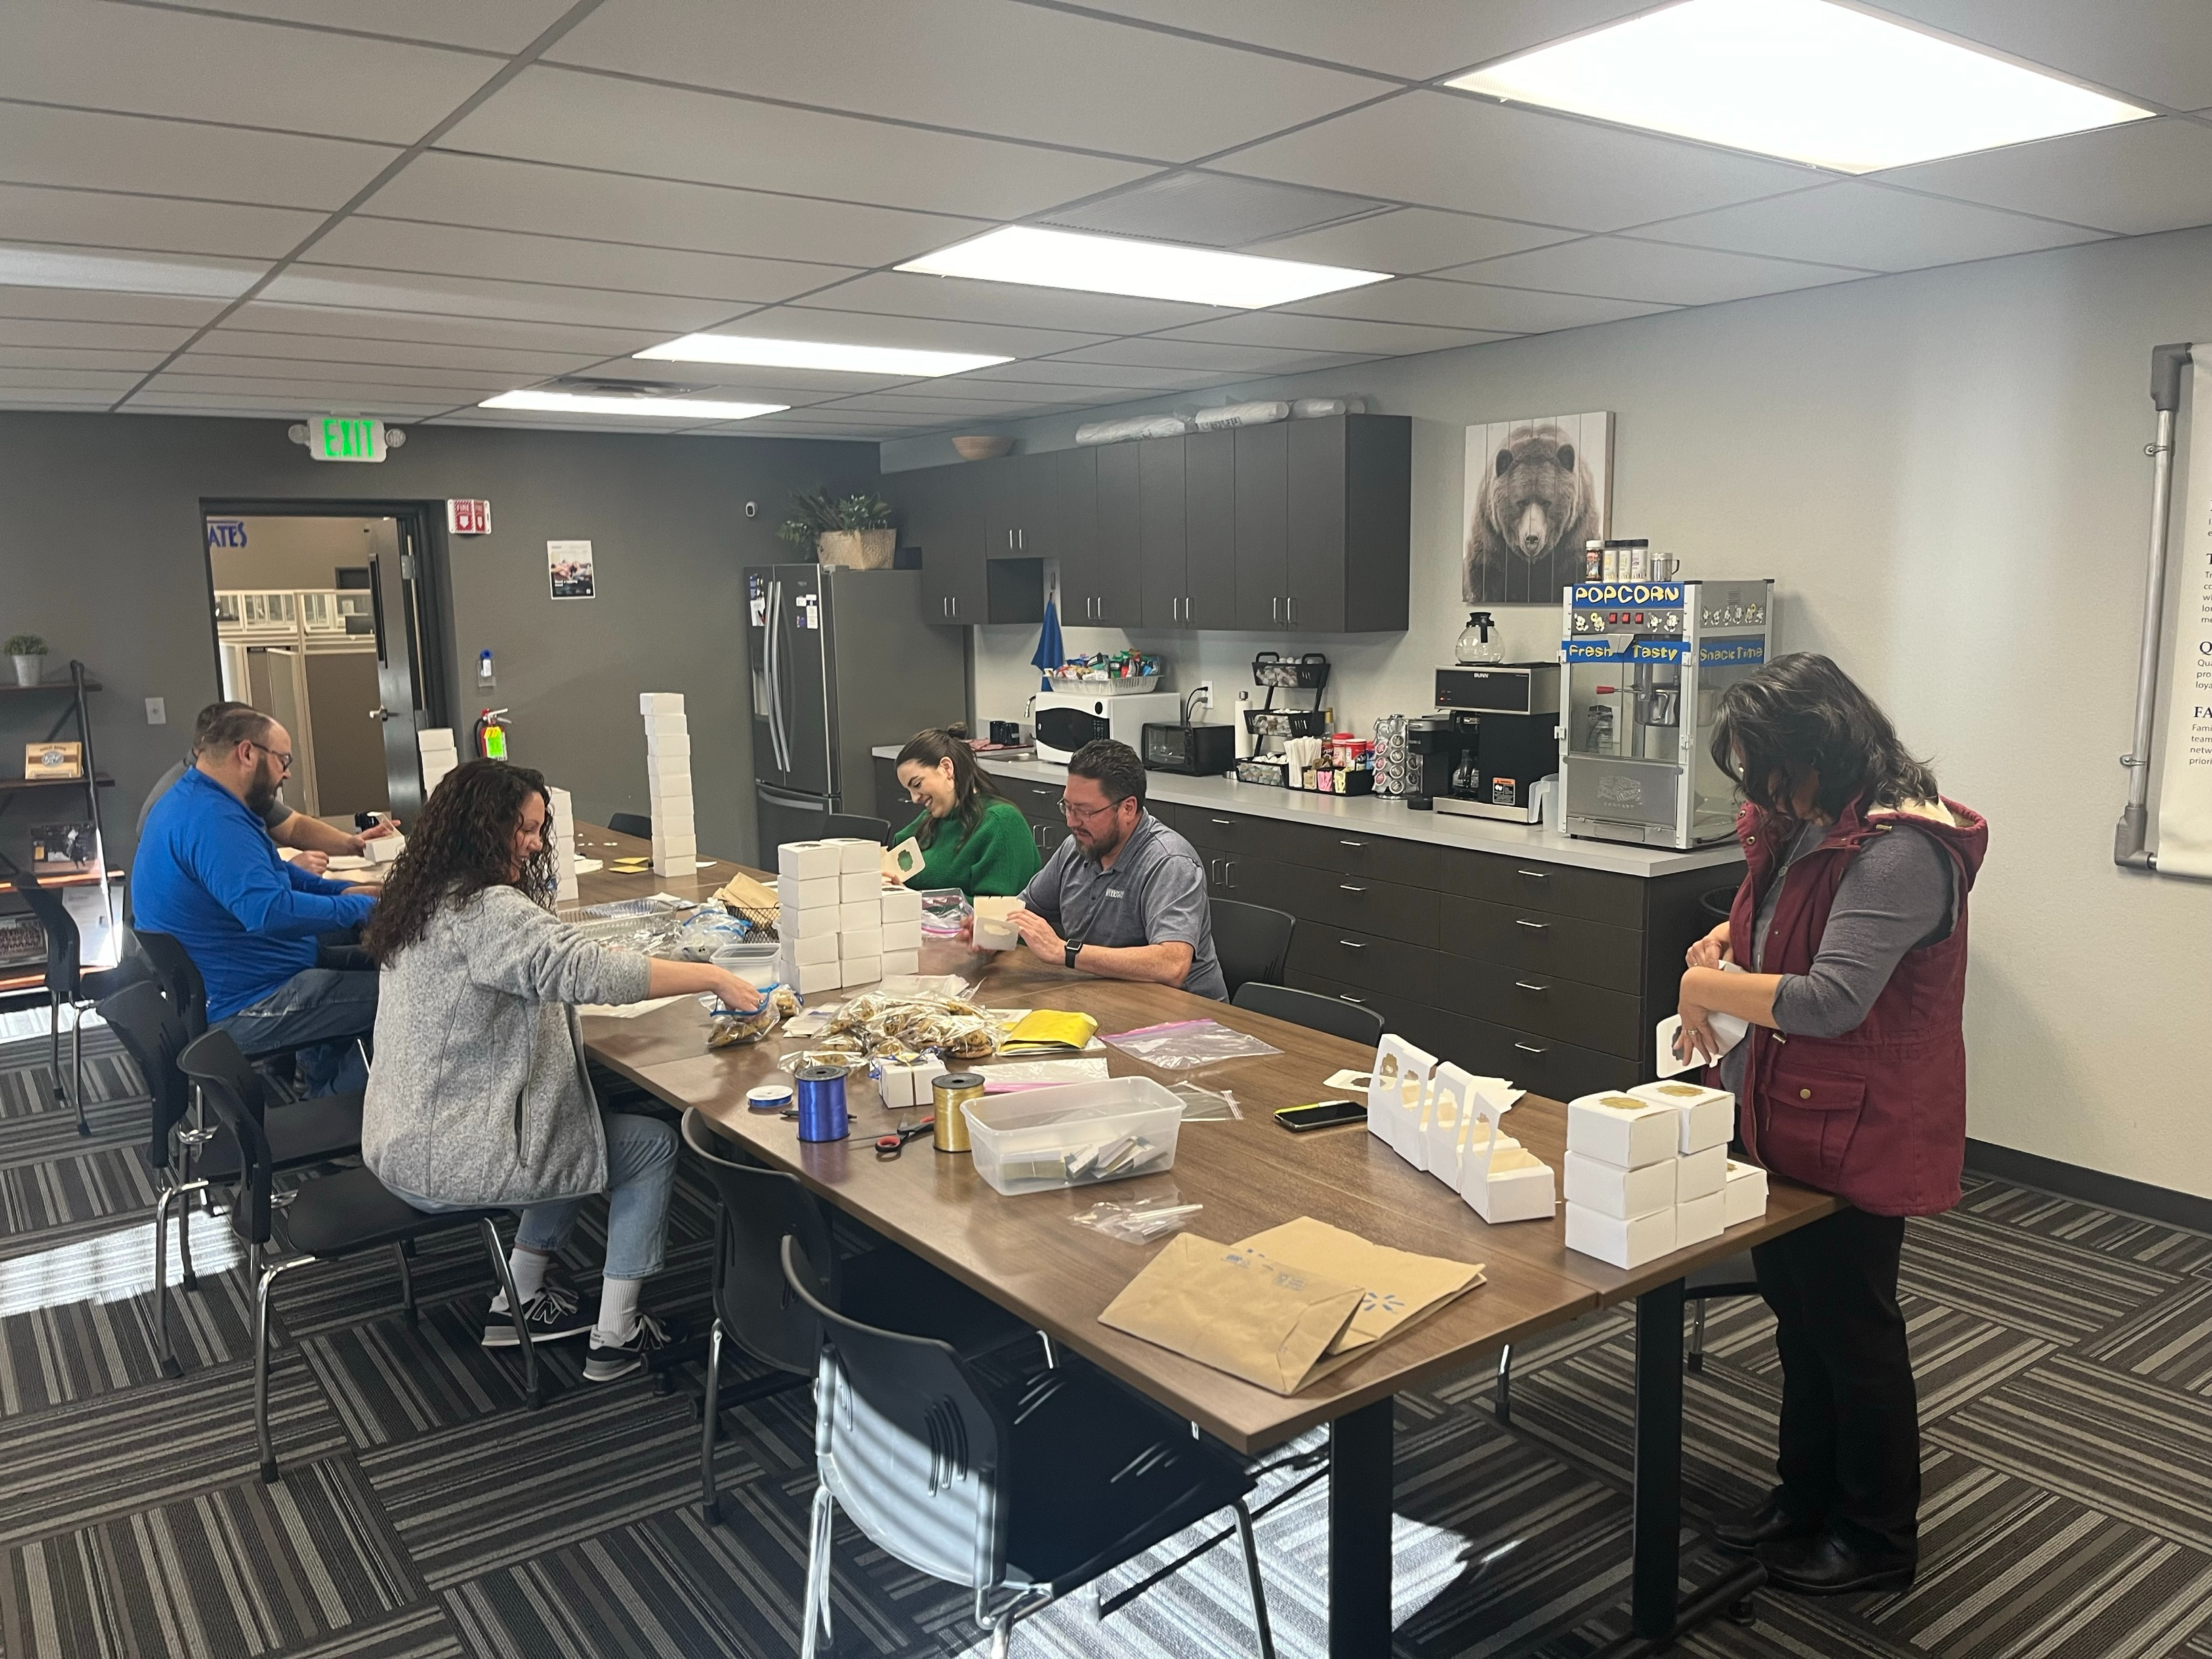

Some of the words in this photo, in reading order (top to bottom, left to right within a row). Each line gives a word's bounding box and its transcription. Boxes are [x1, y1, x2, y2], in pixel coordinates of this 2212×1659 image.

[323, 418, 374, 458] EXIT
[208, 521, 247, 548] ATES
[1576, 585, 1679, 605] POPCORN
[1570, 644, 1613, 657] Fresh
[1633, 644, 1677, 661] Tasty
